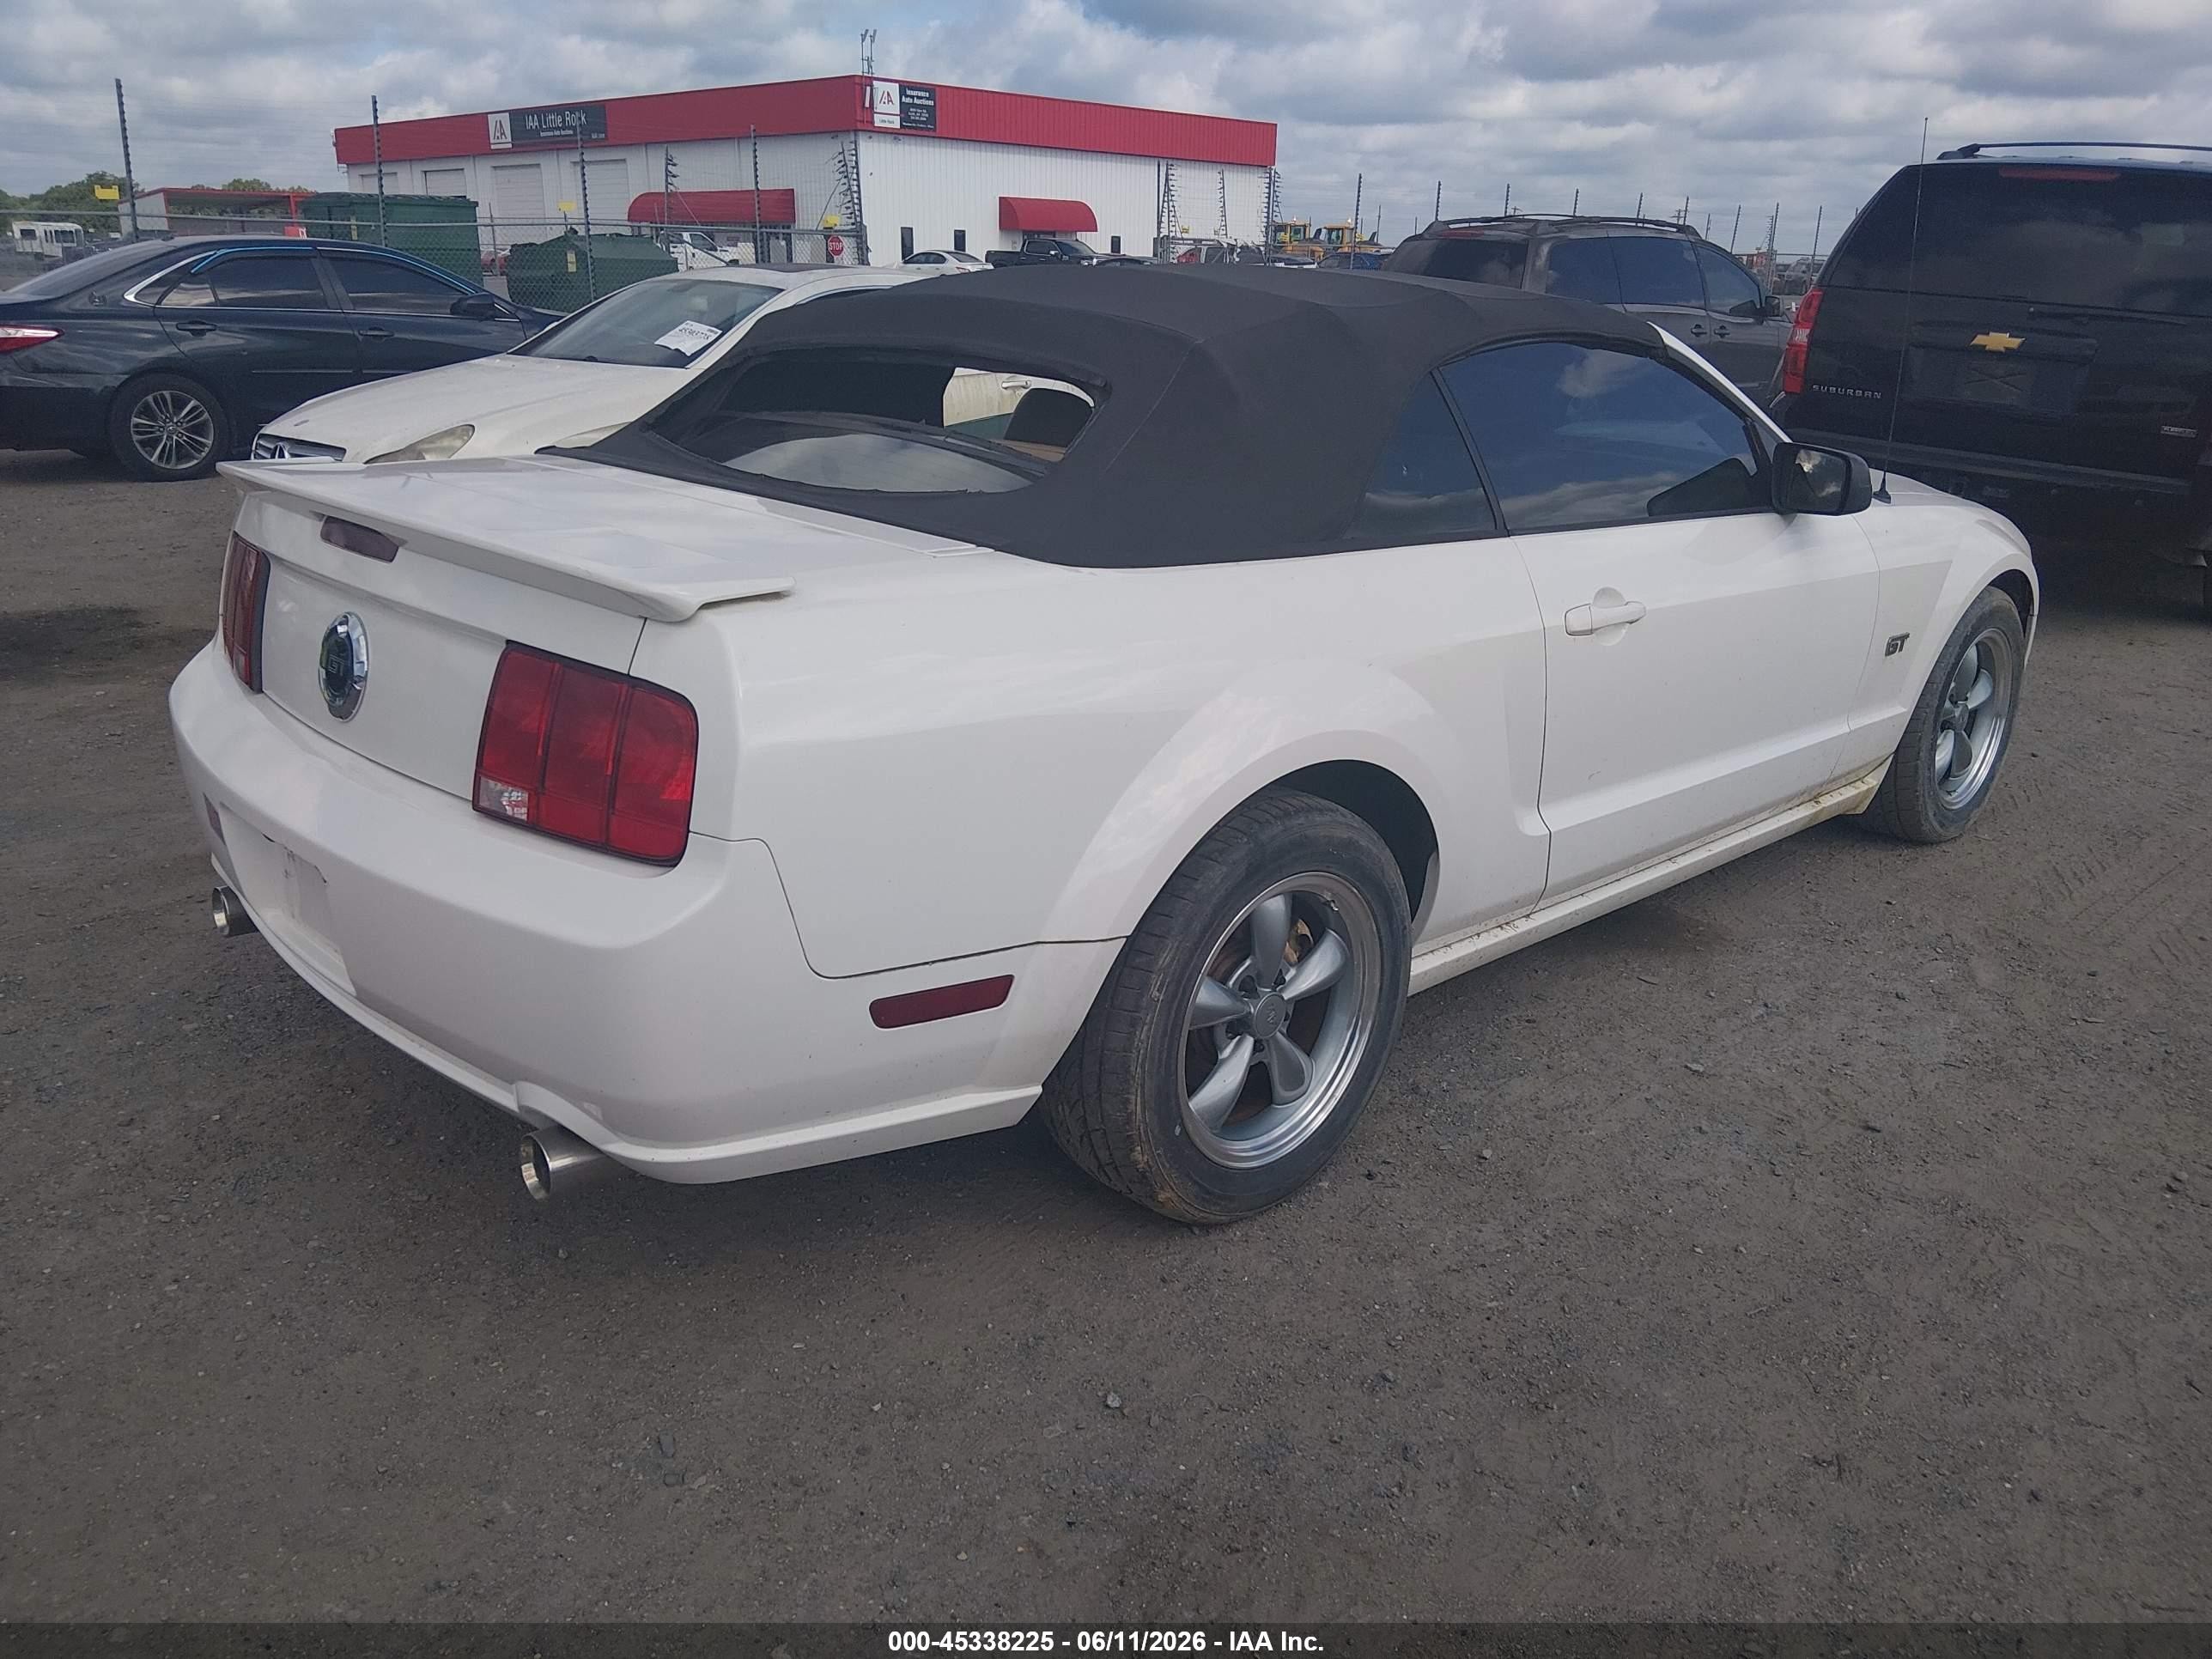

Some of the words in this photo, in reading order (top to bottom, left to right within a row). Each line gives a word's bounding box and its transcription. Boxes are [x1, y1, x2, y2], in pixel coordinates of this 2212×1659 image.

[526, 113, 539, 130] IAA
[541, 112, 563, 129] Little
[830, 242, 843, 251] STOP
[1813, 385, 1881, 399] SUBURBAN
[1885, 632, 1910, 657] GT
